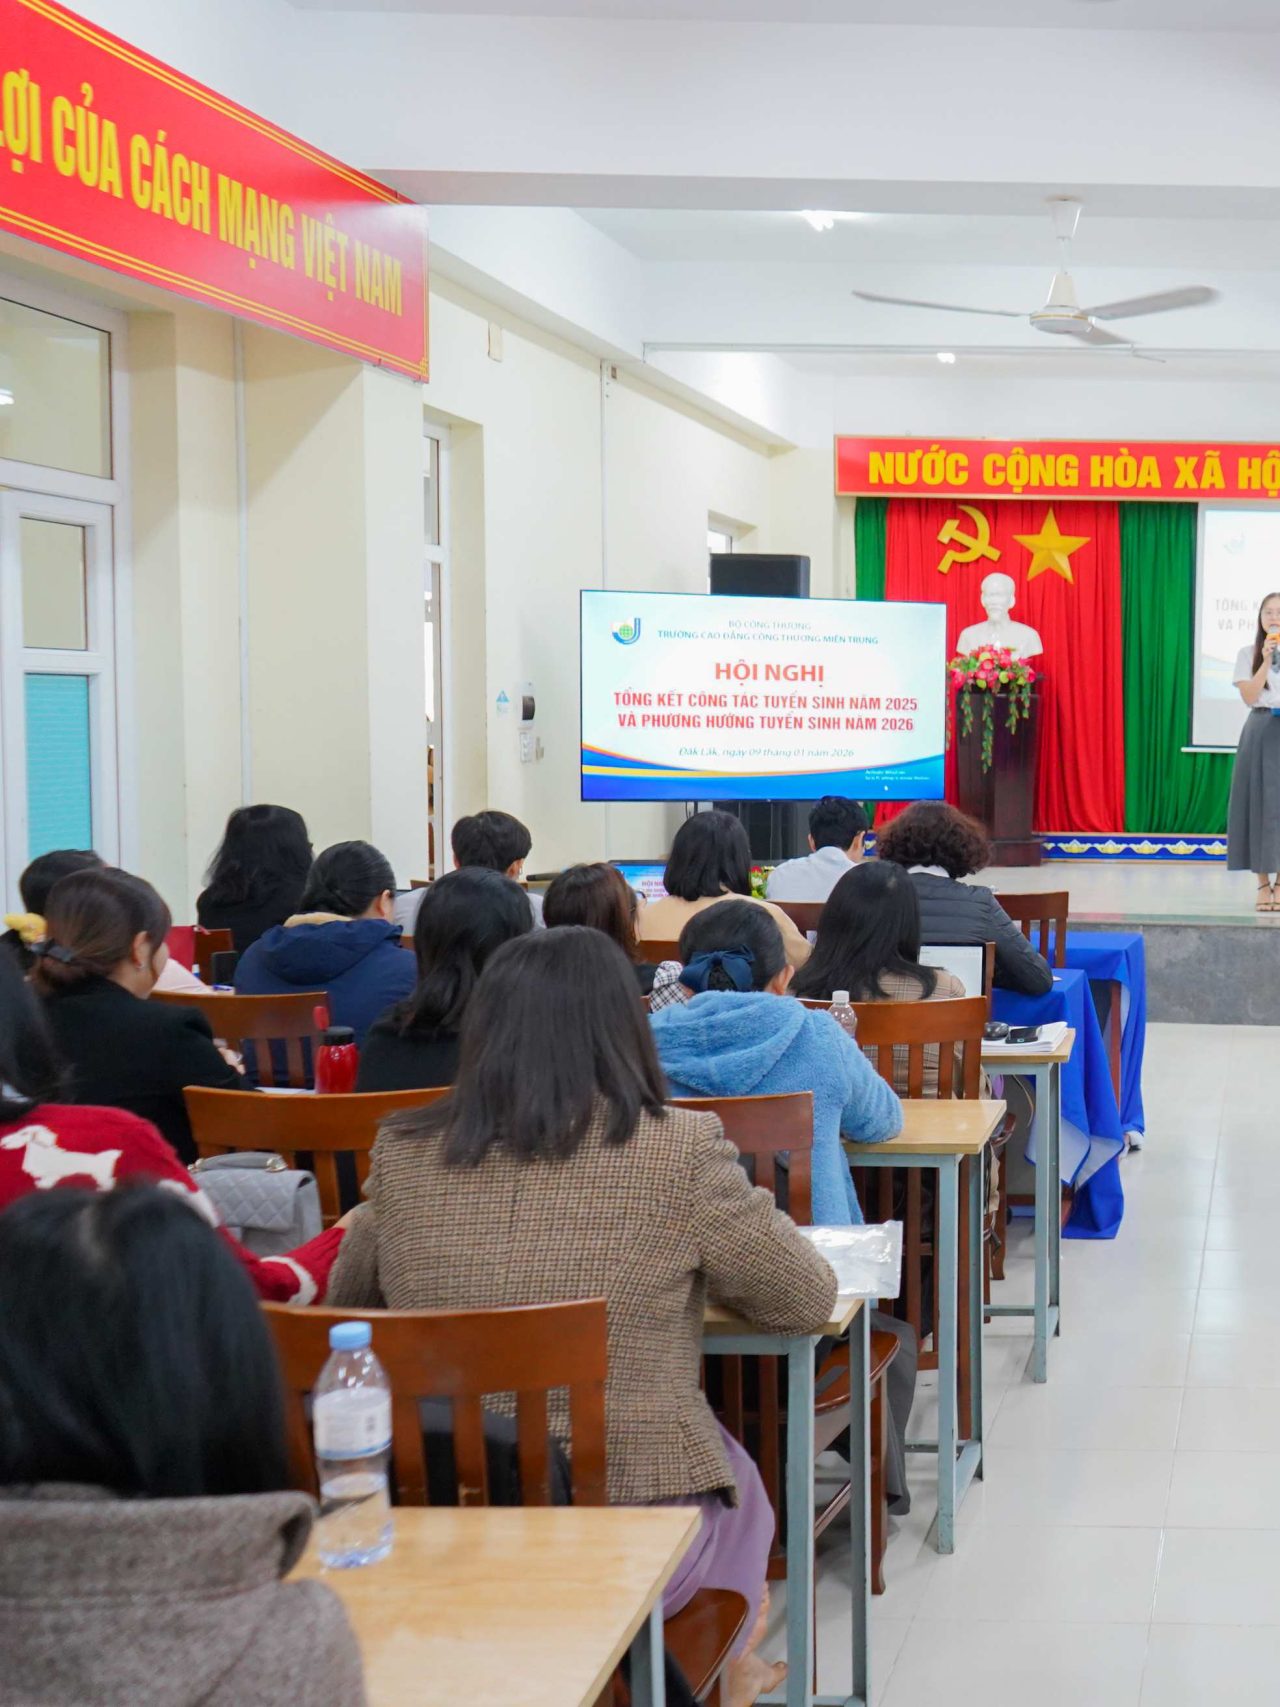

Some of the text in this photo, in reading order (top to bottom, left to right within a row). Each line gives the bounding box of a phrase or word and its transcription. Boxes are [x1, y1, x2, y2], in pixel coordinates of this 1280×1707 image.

[0, 67, 403, 317] ỢI CỦA CÁCH MẠNG VIỆT NAM
[868, 444, 970, 486] NƯỚC
[982, 447, 1079, 493] CỘNG
[1090, 447, 1162, 488] HÒA
[1173, 448, 1226, 490] XÃ
[848, 635, 879, 645] TRUNG
[715, 659, 824, 688] HỘI NGHỊ
[614, 686, 652, 706] TỔNG
[657, 689, 684, 706] KẾT
[688, 691, 727, 707] CÔNG
[733, 691, 758, 708] TÁC
[812, 696, 845, 709] SINH
[849, 694, 881, 710] NĂM
[885, 698, 917, 710] 2025
[618, 710, 637, 727] VÀ
[642, 713, 701, 728] PHƯƠNG
[706, 712, 754, 728] HƯỚNG
[808, 717, 841, 730] SINH
[845, 715, 877, 730] NĂM
[881, 718, 913, 731] 2026
